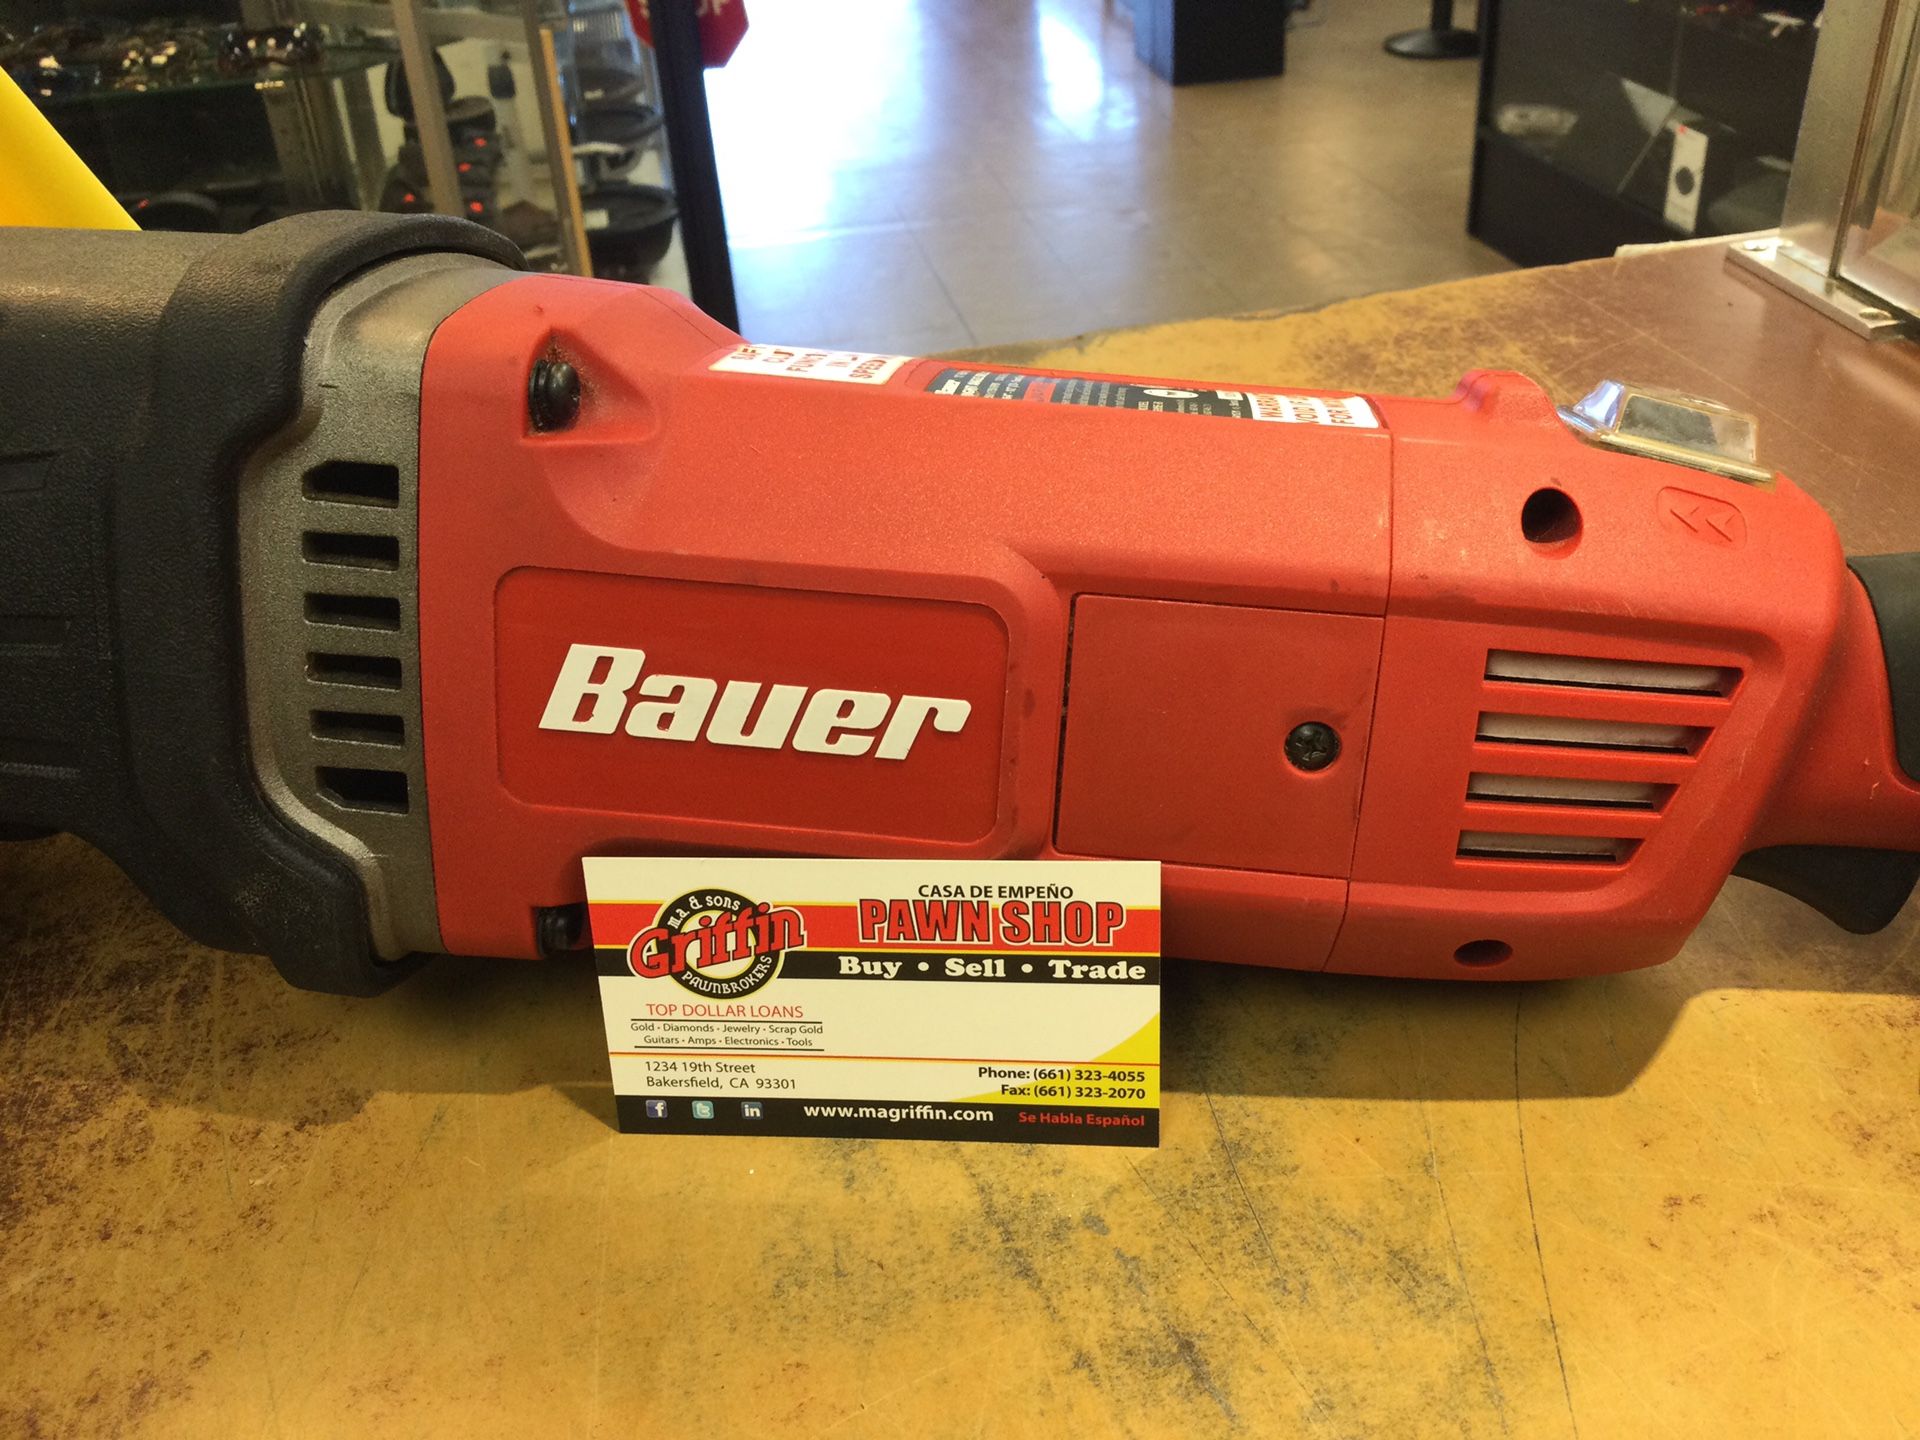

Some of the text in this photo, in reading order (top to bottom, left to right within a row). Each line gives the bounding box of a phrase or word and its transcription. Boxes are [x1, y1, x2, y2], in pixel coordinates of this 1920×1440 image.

[538, 643, 972, 760] Bauer
[918, 882, 1074, 899] CASA DE EMPEÑO
[689, 896, 703, 910] &
[859, 898, 1125, 945] PAWN SHOP
[629, 901, 805, 979] Griffin
[681, 955, 772, 994] PAWNBROKERS
[838, 955, 1146, 980] Buy Sell Trade
[646, 1003, 804, 1018] TOP DOLLAR LOANS
[630, 1022, 823, 1035] Gold Diamonds Jewelry Scrap Gold
[643, 1035, 813, 1047] Guitars Amps Electronics Tools
[645, 1061, 756, 1073] 1234 19th Street
[978, 1066, 1146, 1082] Phone: (661) 323-4055
[646, 1076, 796, 1089] Bakersfield, CA 93301
[1001, 1084, 1146, 1099] Fax: (661) 323-2070
[803, 1103, 995, 1122] www.magriffin.com
[1018, 1111, 1145, 1127] Se Habla Español
